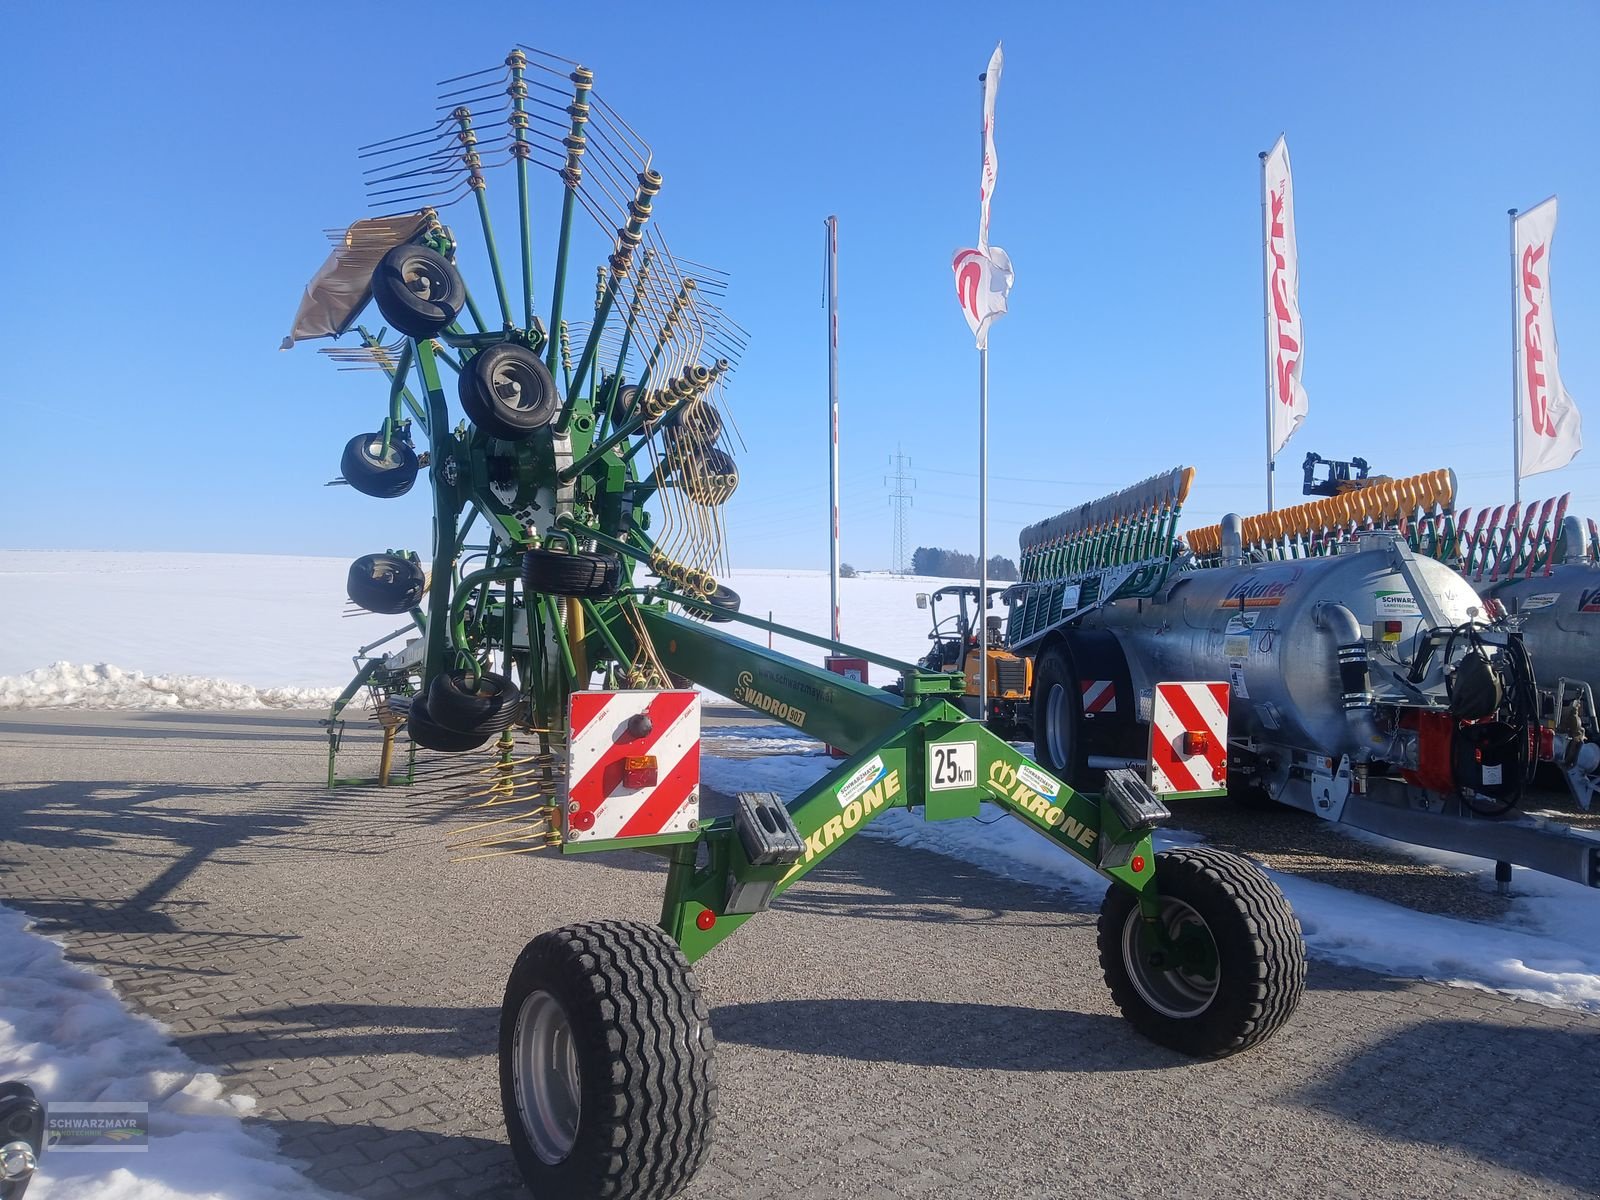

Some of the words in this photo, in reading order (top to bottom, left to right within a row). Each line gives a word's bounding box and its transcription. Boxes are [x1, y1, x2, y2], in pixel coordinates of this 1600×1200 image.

[1522, 242, 1558, 438] STEYR
[1382, 596, 1416, 604] SCHWARZ
[734, 670, 788, 719] SWADRO
[789, 709, 804, 724] 907
[840, 764, 876, 795] SCHWARZMAYR
[934, 748, 958, 784] 25
[958, 765, 973, 783] km
[803, 769, 900, 863] KRONE
[1011, 784, 1098, 849] KRONE
